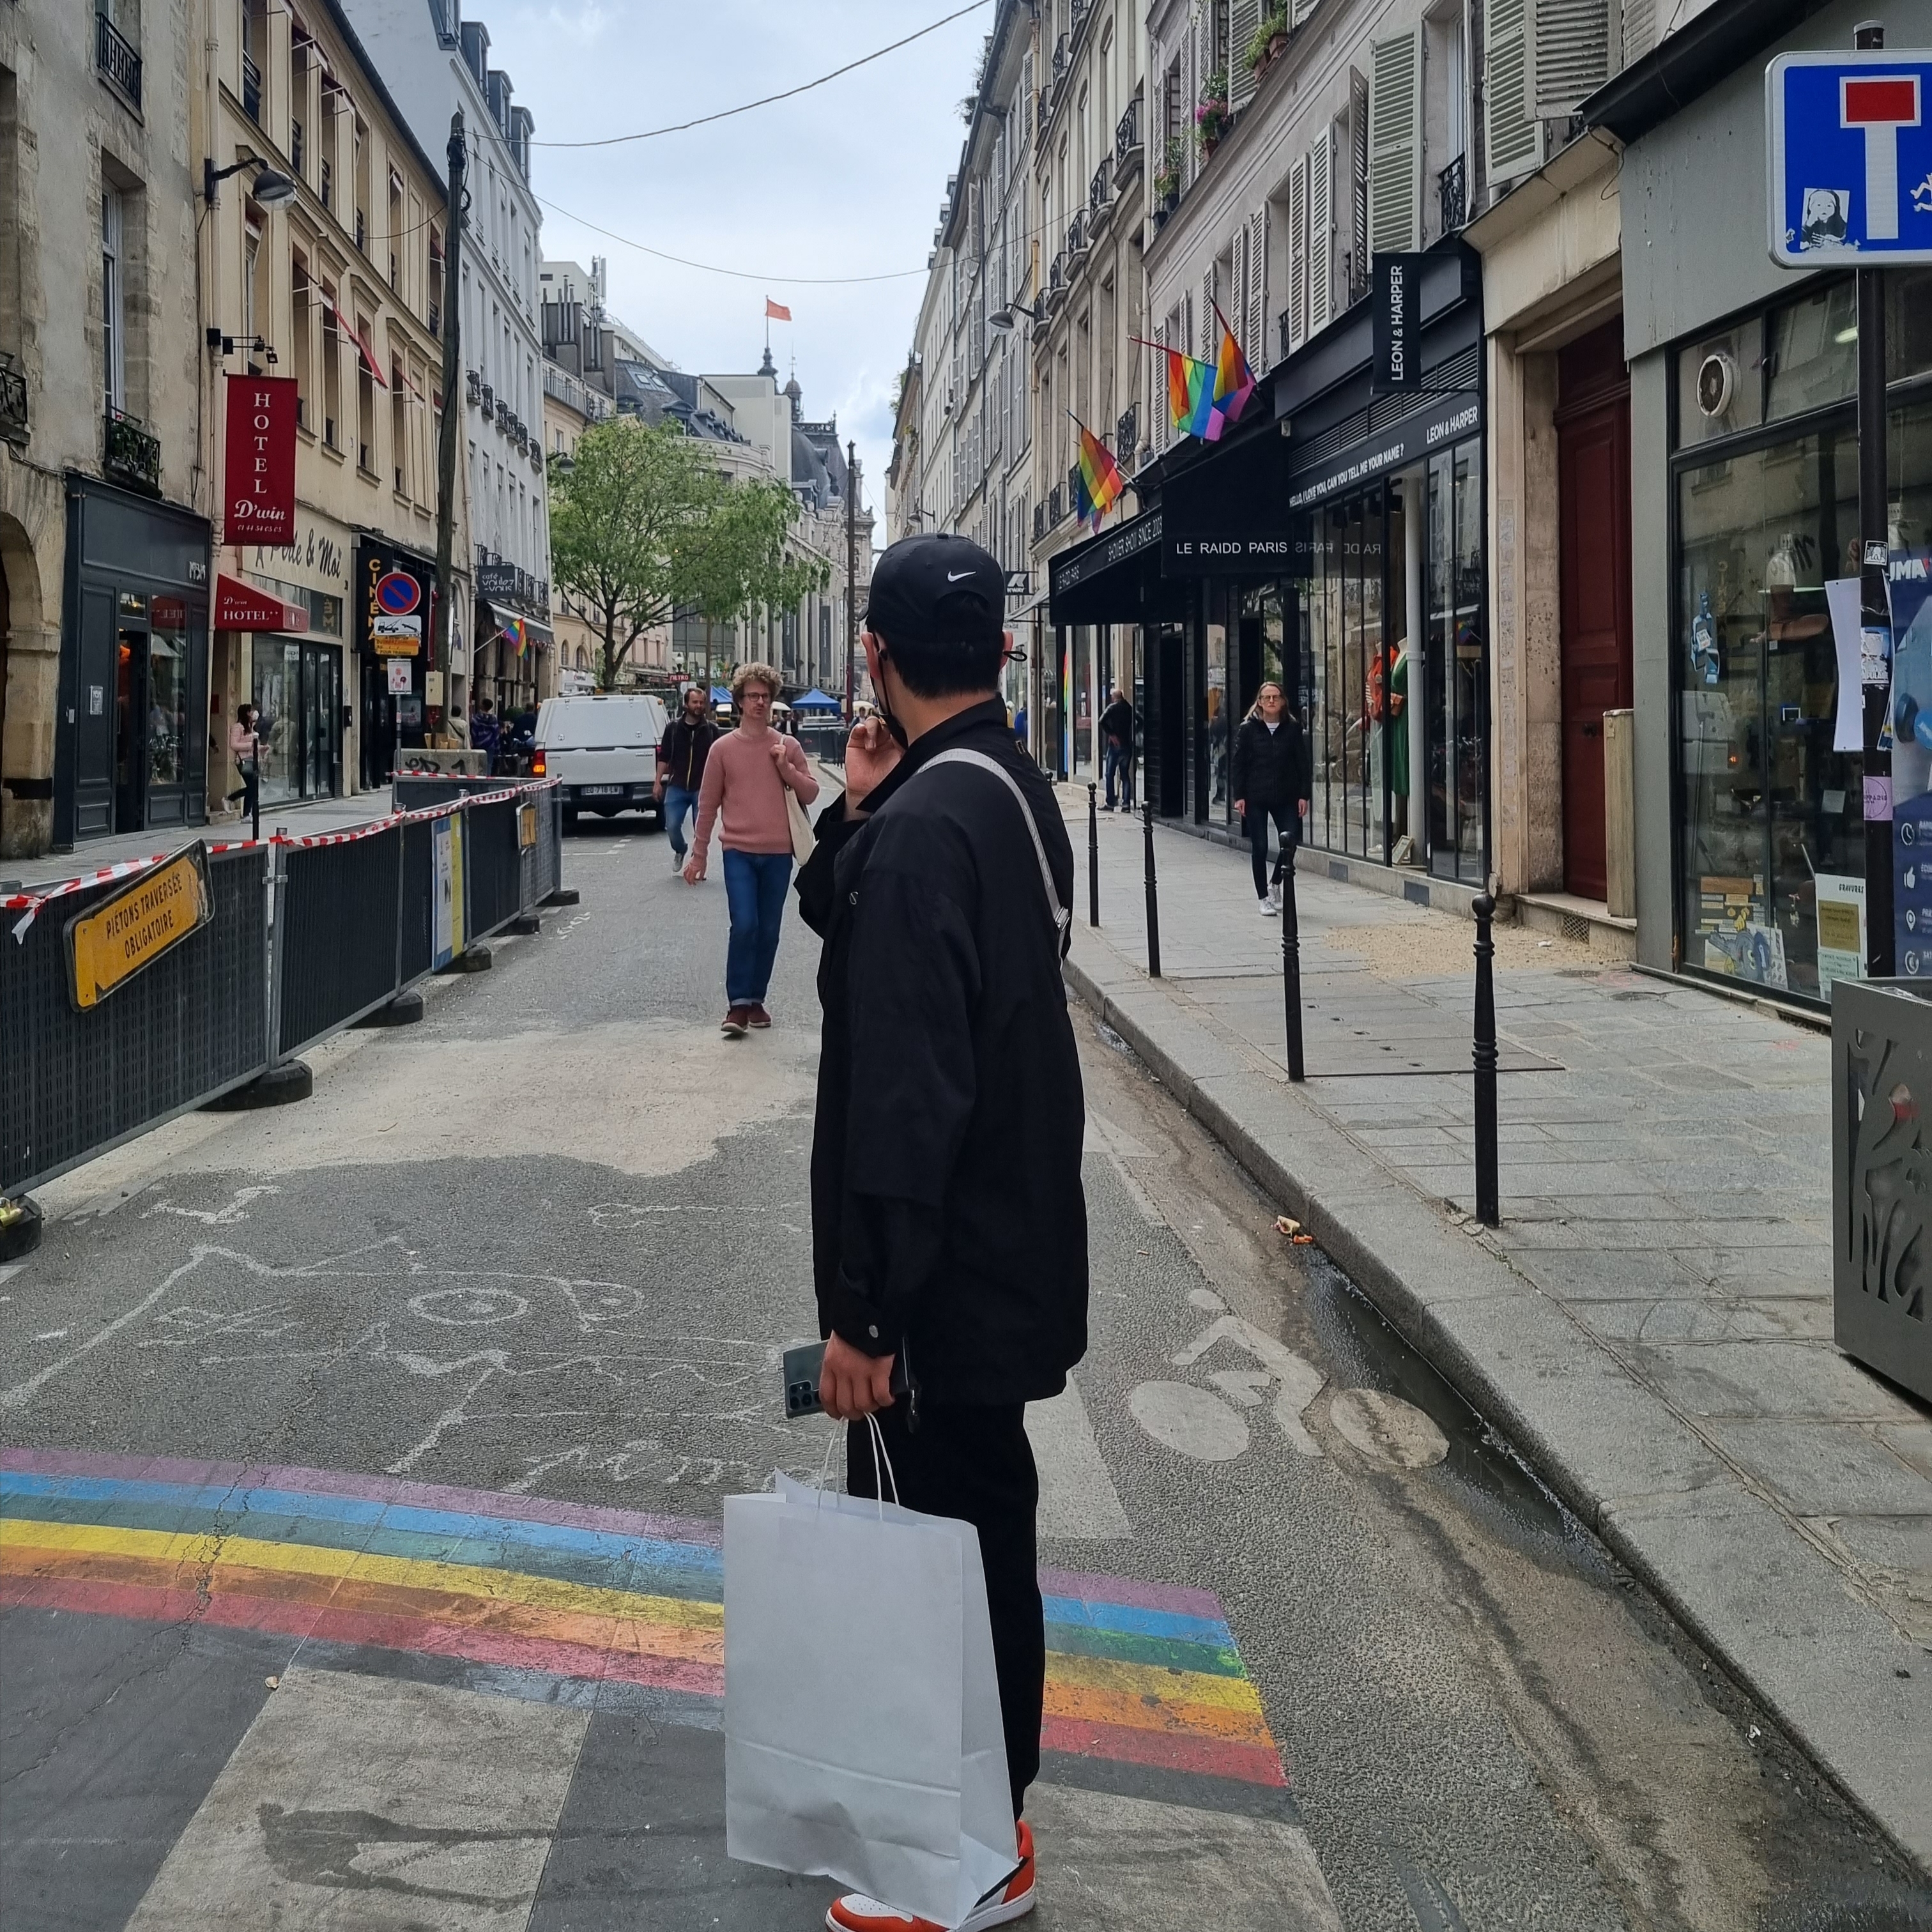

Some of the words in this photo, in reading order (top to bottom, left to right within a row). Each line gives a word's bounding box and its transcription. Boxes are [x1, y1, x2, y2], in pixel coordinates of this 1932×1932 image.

[1390, 265, 1403, 325] HARPER
[1392, 328, 1403, 337] &
[1391, 340, 1404, 381] LEON
[254, 392, 271, 494] HOTEL
[1426, 422, 1445, 445] LEON
[1445, 422, 1450, 436] &
[1450, 405, 1478, 434] HARPER
[1305, 486, 1316, 501] LOVE
[1326, 476, 1337, 491] CAN
[1337, 470, 1348, 486] YOU
[1347, 464, 1360, 481] TELL
[1360, 460, 1368, 475] ME
[1368, 454, 1383, 471] YOUR
[1383, 445, 1400, 466] NAME
[234, 499, 286, 521] D'win
[306, 528, 314, 568] &
[1176, 542, 1192, 554] LE
[1200, 542, 1241, 554] RAIDD
[1249, 542, 1287, 553] PARIS
[224, 610, 270, 621] HOTEL
[106, 901, 139, 939] PIÉTONS
[140, 872, 183, 916] TRAVERSÉE
[1839, 884, 1864, 894] GRAVURES
[125, 910, 174, 959] OBLIGATOIRE
